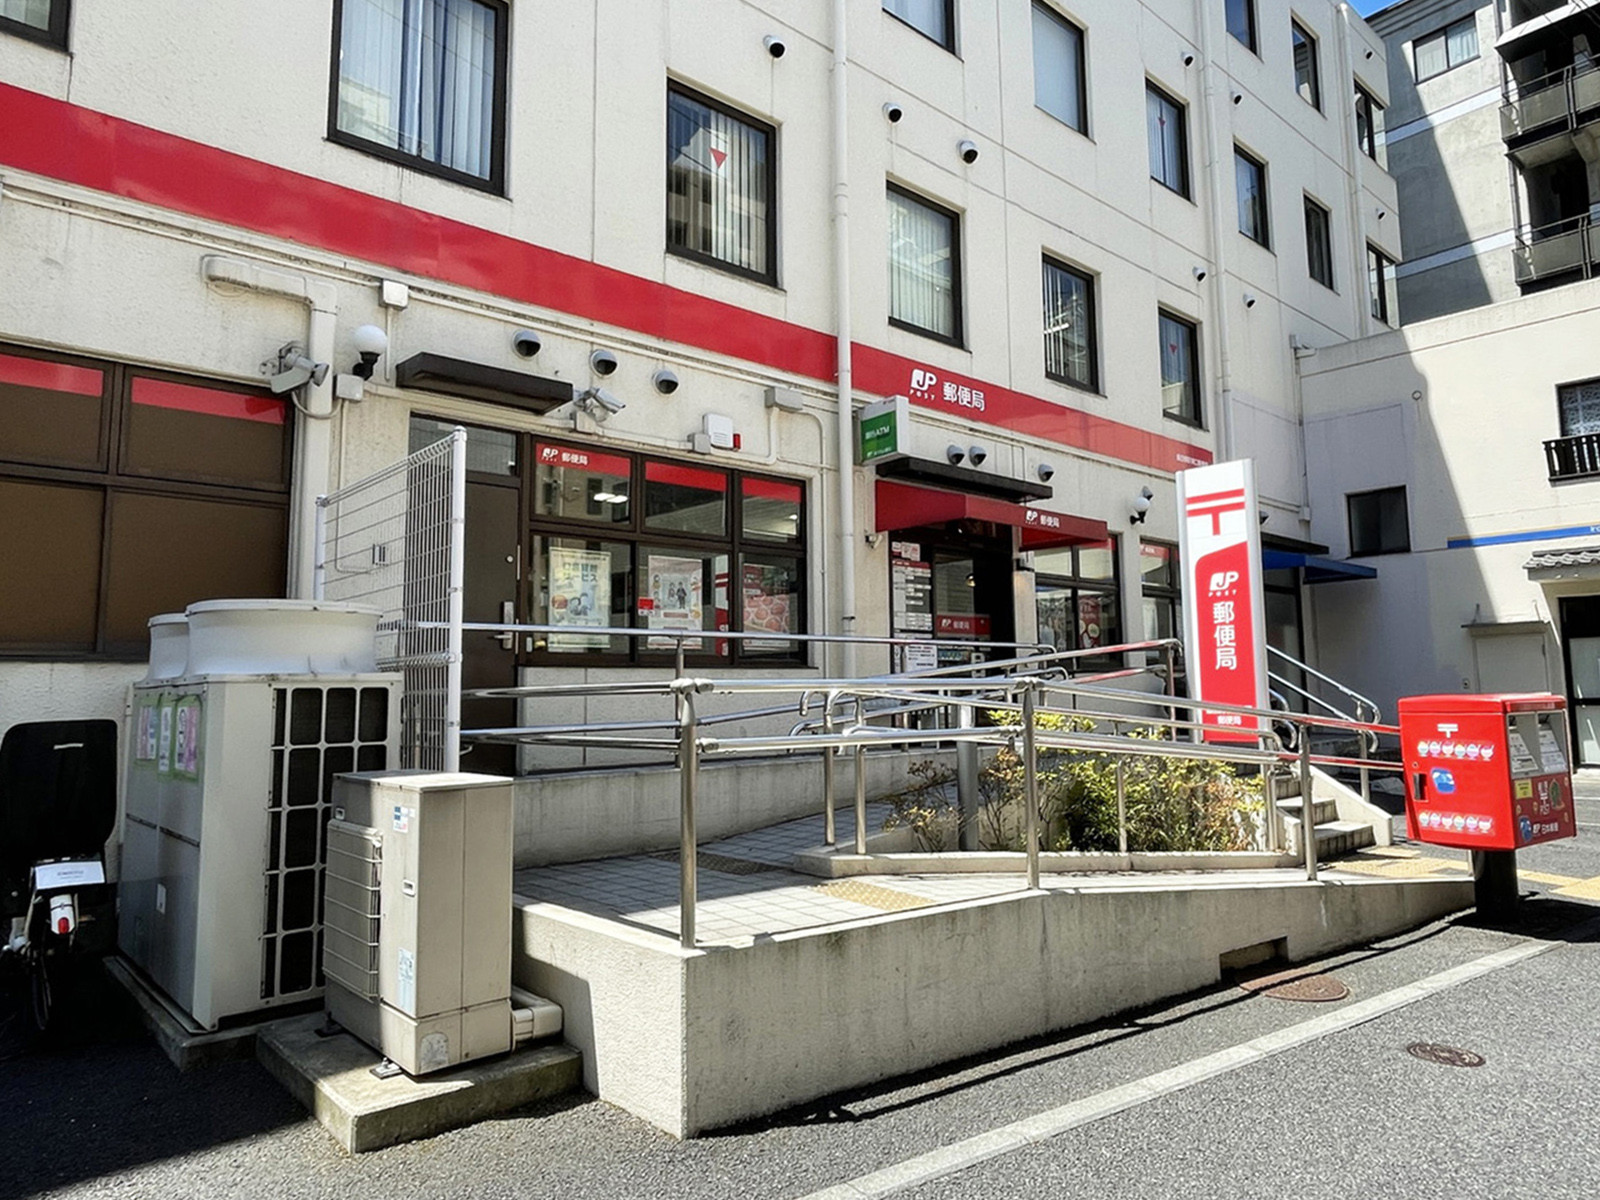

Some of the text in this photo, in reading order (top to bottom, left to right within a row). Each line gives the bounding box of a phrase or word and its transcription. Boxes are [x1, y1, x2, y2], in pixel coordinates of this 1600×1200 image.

[911, 369, 985, 412] JP 郵便局
[561, 452, 589, 466] 郵便局
[1040, 514, 1060, 528] 郵便局
[1210, 571, 1239, 590] JP
[1213, 601, 1238, 670] 郵便局
